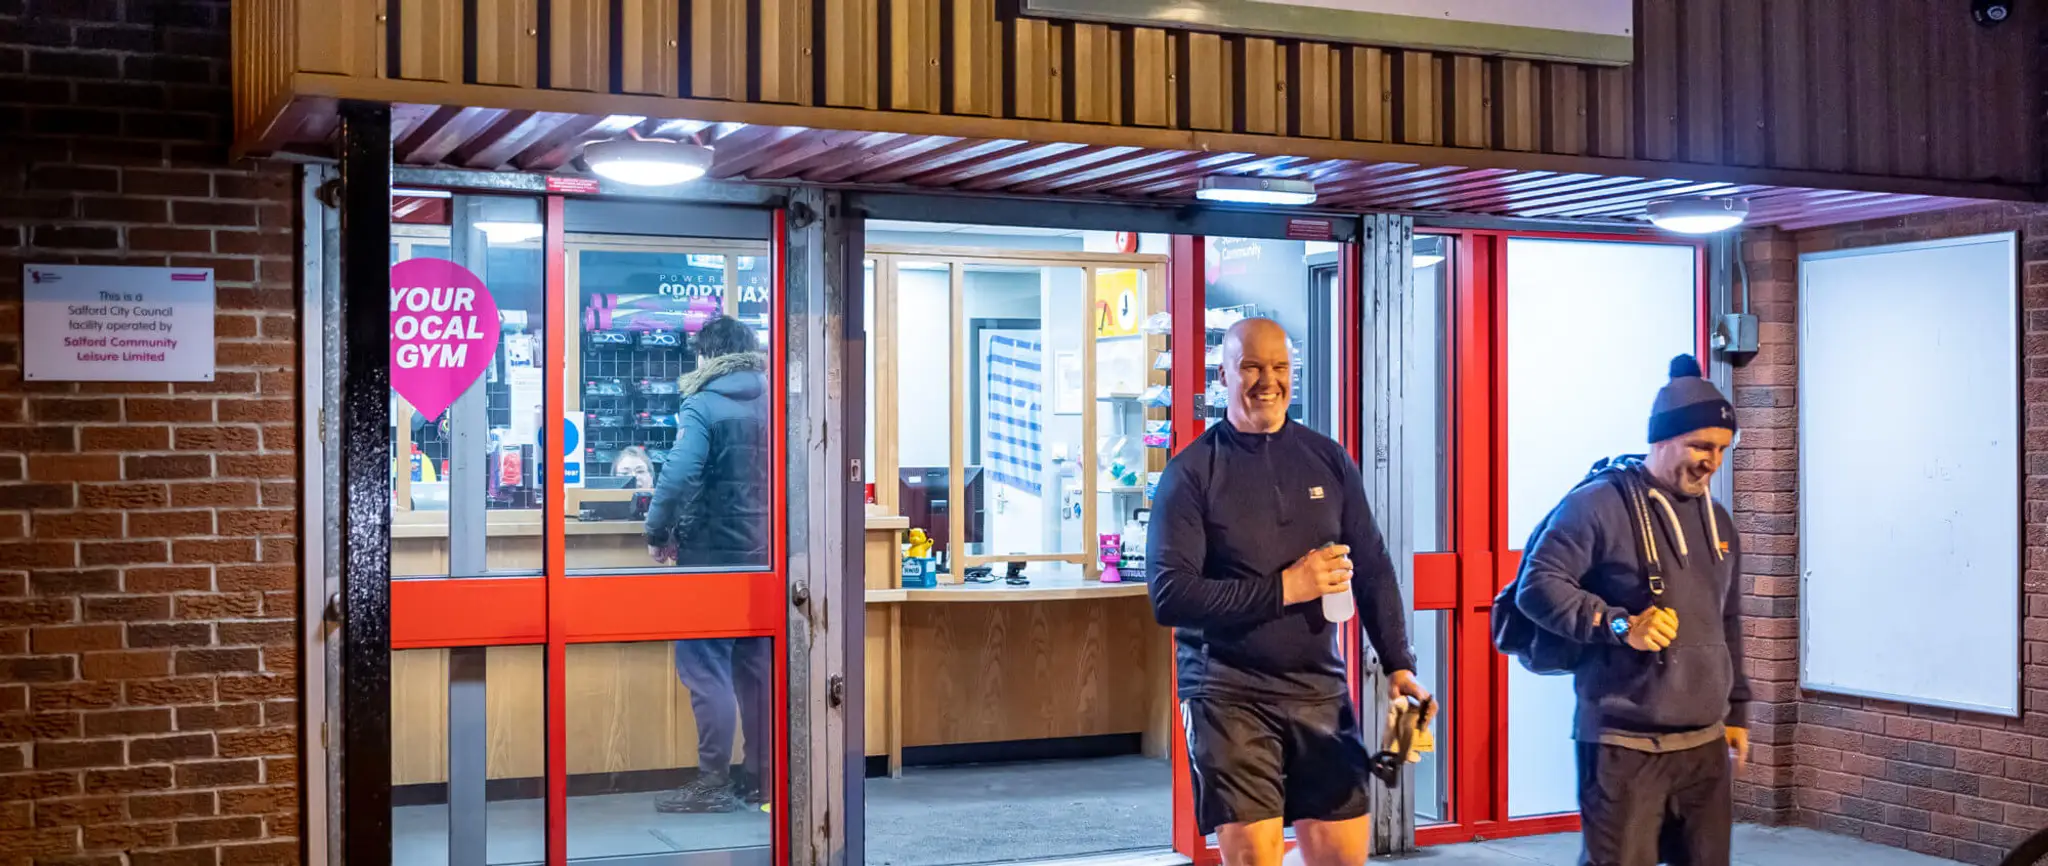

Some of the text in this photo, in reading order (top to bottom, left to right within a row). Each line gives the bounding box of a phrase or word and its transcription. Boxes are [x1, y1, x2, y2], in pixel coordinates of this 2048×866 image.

[660, 274, 728, 283] POWERE
[99, 291, 143, 302] This is a
[390, 286, 476, 312] YOUR
[659, 283, 769, 302] SPORTAX
[68, 304, 173, 318] Salford City Council
[68, 320, 173, 333] facility operated by
[390, 315, 485, 340] OCAL
[64, 337, 178, 349] Salford Community
[77, 351, 165, 361] Leisure Limited
[396, 343, 468, 368] GYM
